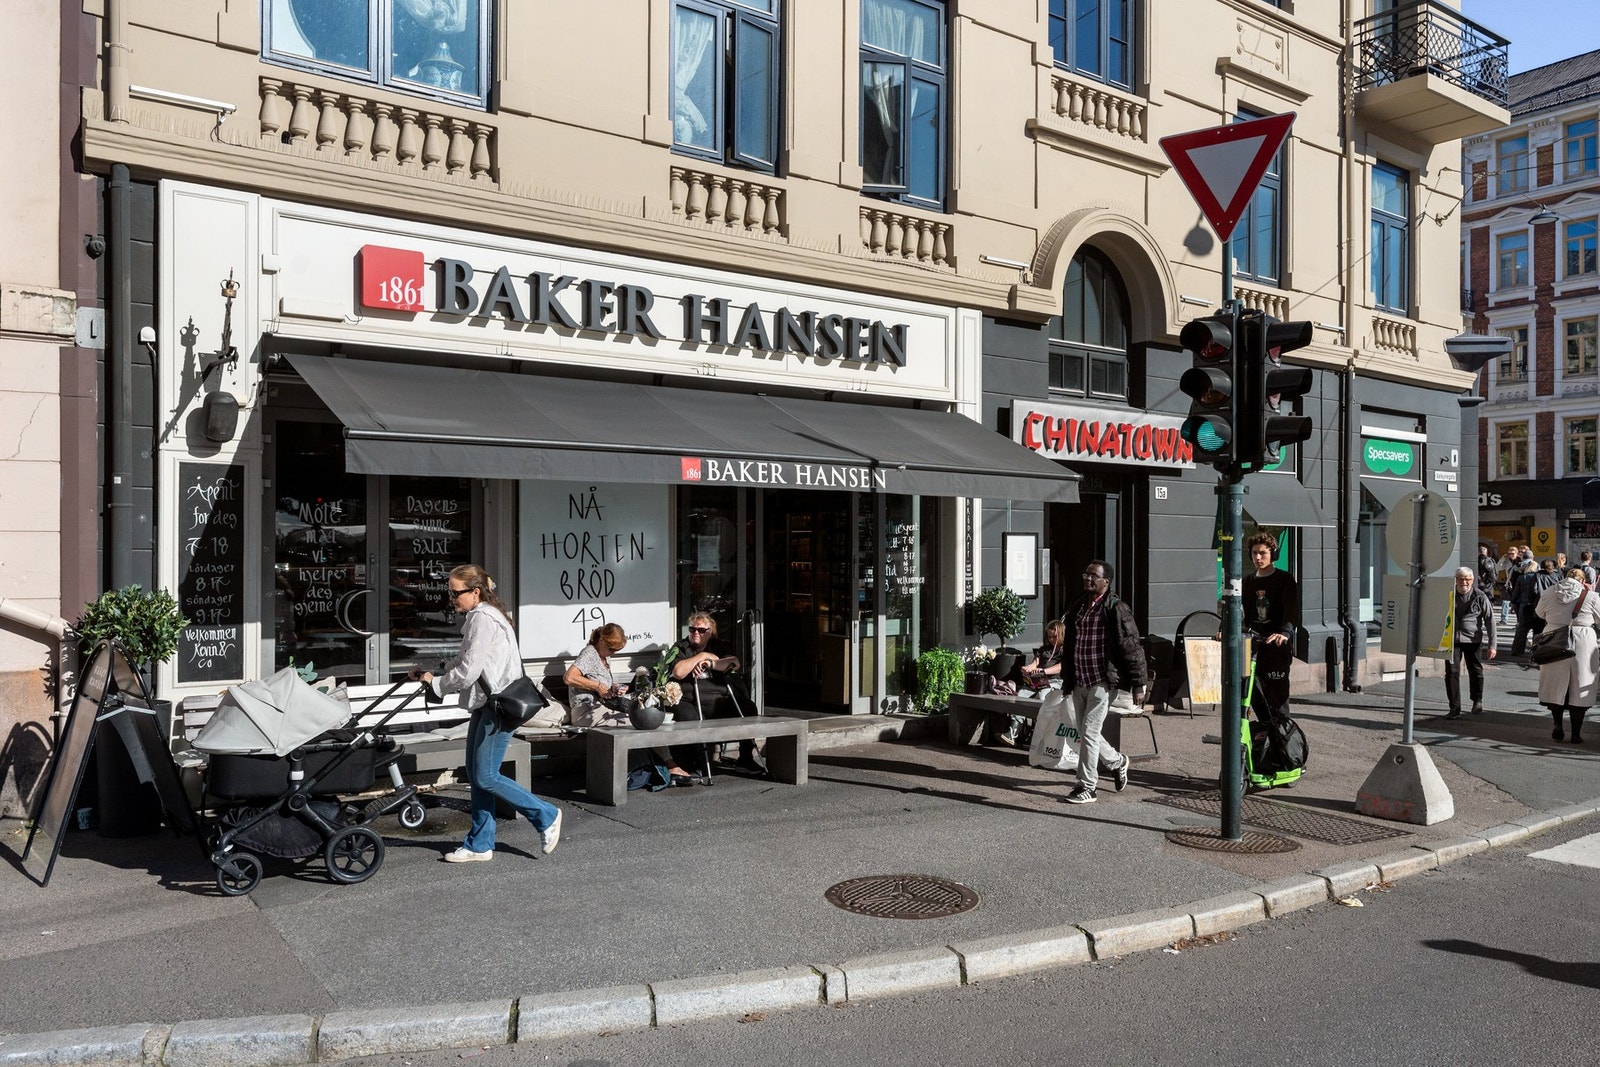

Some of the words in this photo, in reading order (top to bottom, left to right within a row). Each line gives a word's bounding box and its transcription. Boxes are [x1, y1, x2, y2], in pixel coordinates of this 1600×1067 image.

[379, 276, 425, 307] 1861
[430, 257, 667, 339] BAKER
[679, 293, 910, 367] HANSEN
[1022, 411, 1193, 464] CHINATOWN
[1368, 446, 1410, 463] Specsavers
[686, 467, 701, 479] 1861
[706, 459, 788, 484] BAKER
[795, 464, 887, 489] HANSEN
[407, 495, 458, 515] Dagens
[569, 486, 606, 521] NÅ
[1156, 487, 1166, 498] 15a
[188, 505, 210, 530] for
[212, 509, 238, 528] deg
[539, 531, 655, 565] HORTEN-
[306, 586, 333, 600] deg
[560, 564, 615, 600] BRÖD
[571, 606, 605, 640] 49
